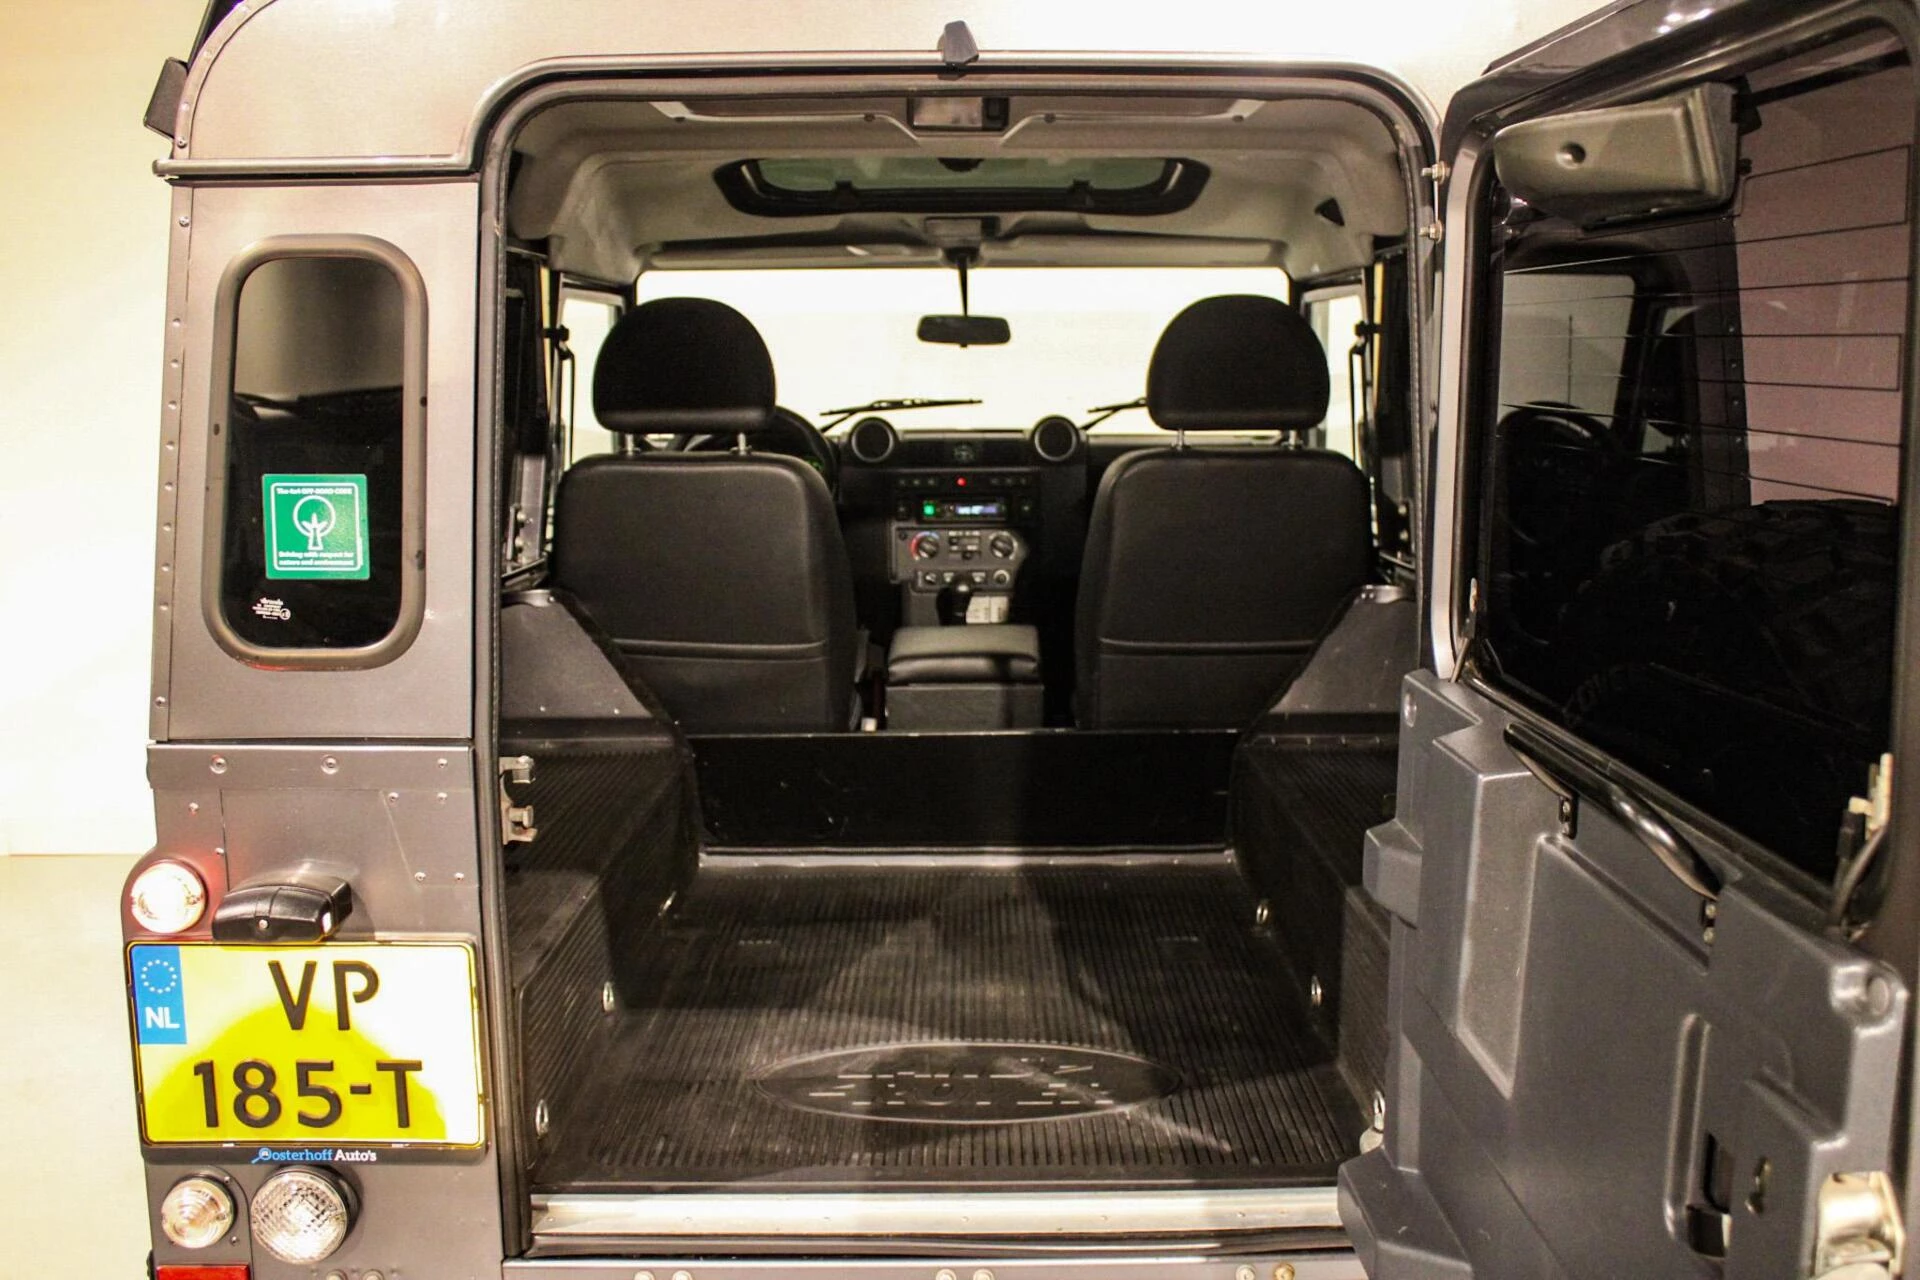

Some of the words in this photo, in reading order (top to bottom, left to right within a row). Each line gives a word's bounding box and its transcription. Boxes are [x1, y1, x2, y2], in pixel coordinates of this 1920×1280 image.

[145, 1006, 180, 1029] NL
[268, 960, 380, 1031] VP
[193, 1058, 423, 1129] 185-T
[252, 1147, 333, 1164] Oosterhoff
[334, 1149, 377, 1162] Auto's
